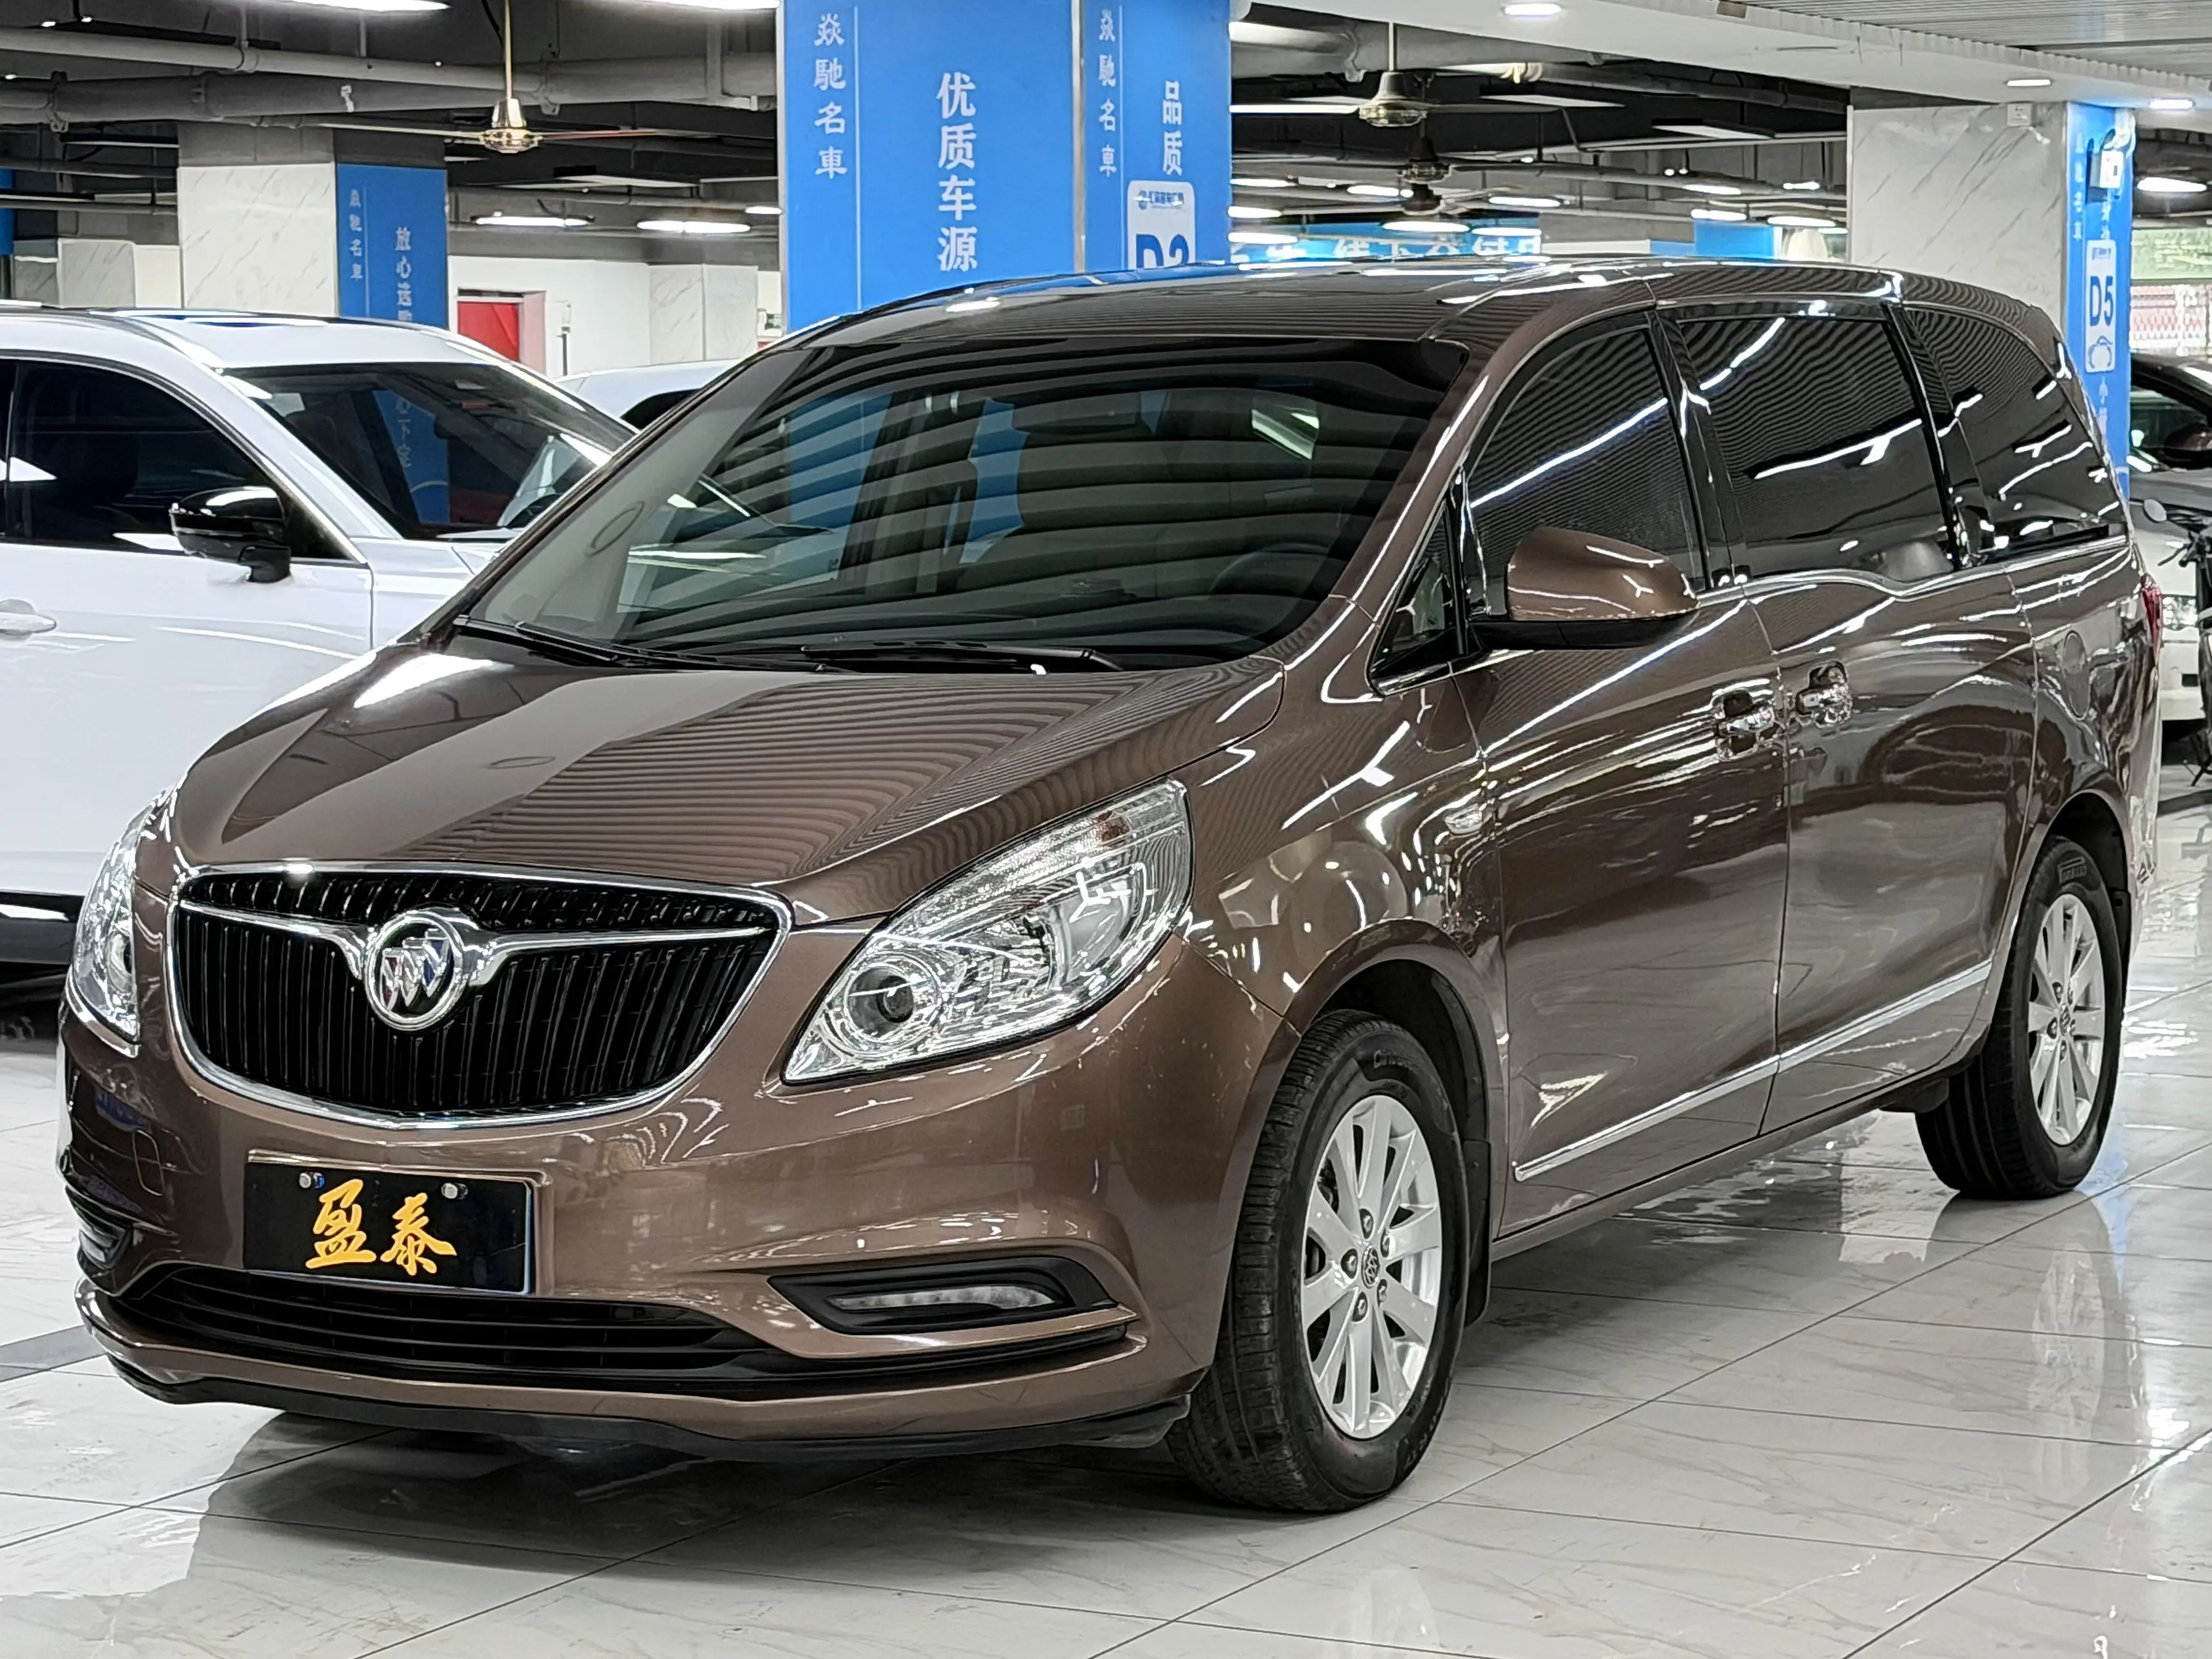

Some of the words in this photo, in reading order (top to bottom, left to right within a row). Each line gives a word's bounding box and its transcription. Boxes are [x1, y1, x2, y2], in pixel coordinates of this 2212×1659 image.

[936, 72, 978, 273] 优质车源
[1162, 80, 1183, 177] 品质
[2089, 275, 2114, 327] D5
[305, 1178, 457, 1276] 盈泰
